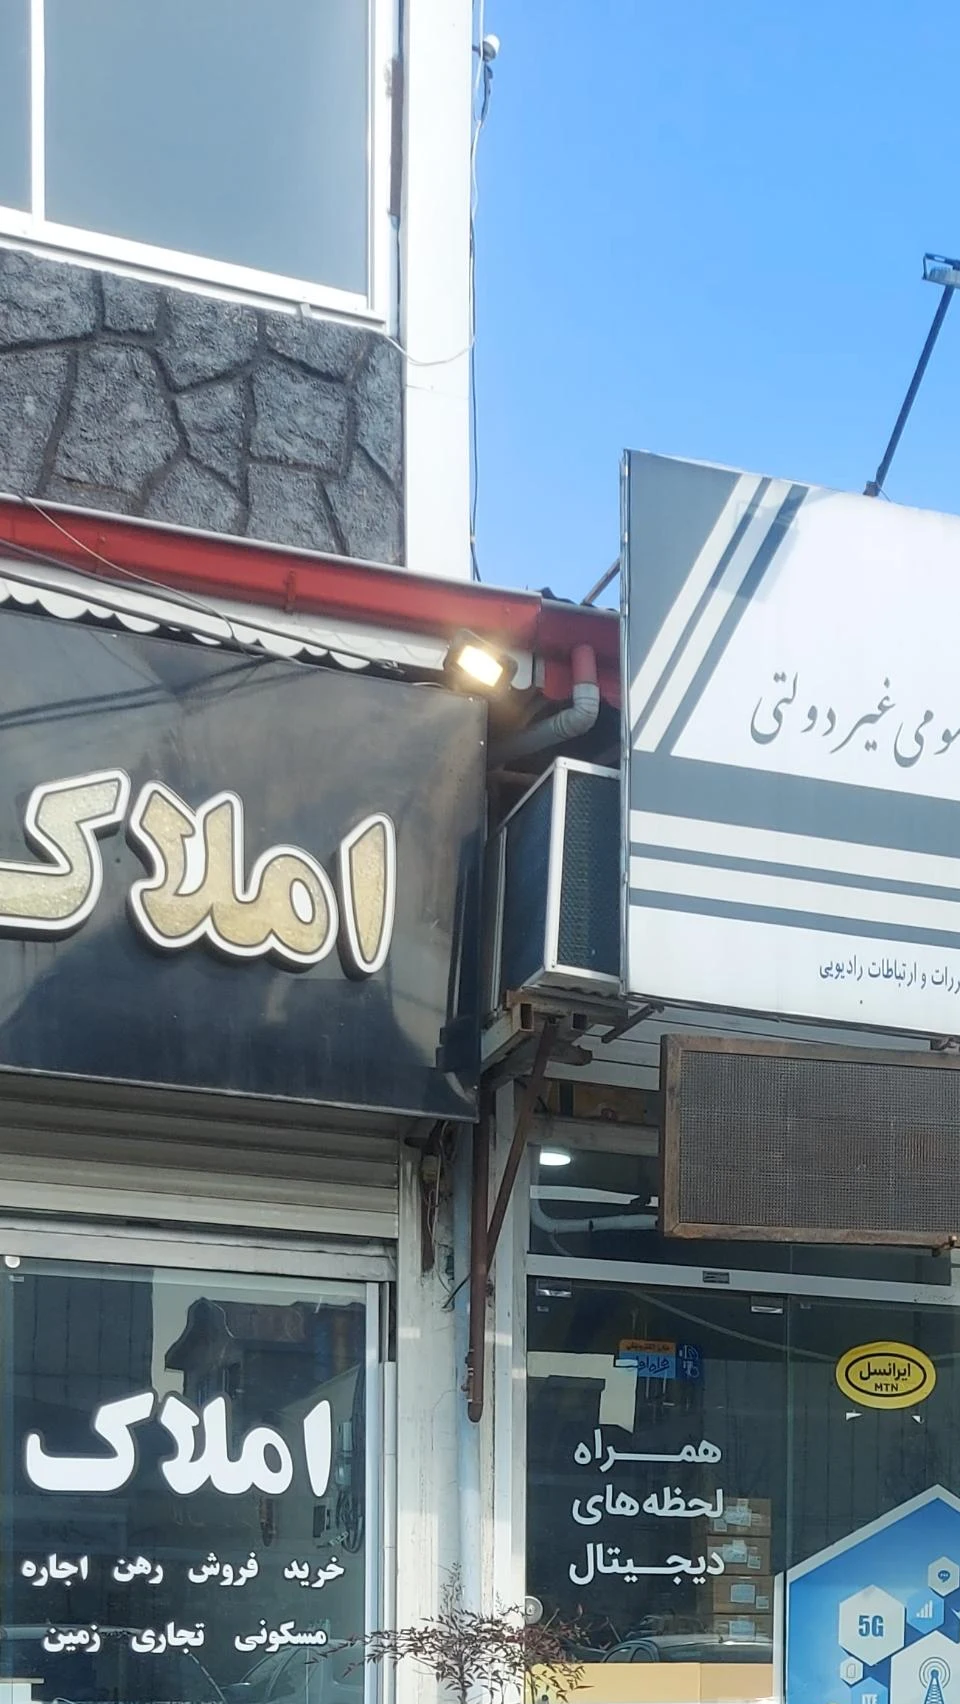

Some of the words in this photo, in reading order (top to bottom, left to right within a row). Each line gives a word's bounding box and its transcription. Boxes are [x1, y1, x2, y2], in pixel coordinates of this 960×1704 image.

[749, 671, 837, 746] دولتی
[828, 676, 897, 755] غیر
[0, 767, 397, 975] املاک
[819, 954, 863, 982] رادیویی
[867, 957, 918, 988] ارتباطات
[920, 972, 927, 990] و
[858, 1361, 912, 1382] ایرانسل
[873, 1381, 899, 1393] MTN
[25, 1392, 333, 1498] املاک
[573, 1428, 723, 1473] همراه
[21, 1553, 90, 1587] اجاره
[112, 1555, 164, 1585] رهن
[187, 1551, 260, 1587] فروش
[283, 1555, 346, 1589] خرید
[568, 1542, 726, 1586] دیجیتال
[42, 1623, 102, 1653] زمین
[130, 1622, 206, 1655] تجاری
[233, 1617, 328, 1653] مسکونی
[857, 1614, 885, 1638] 5G
